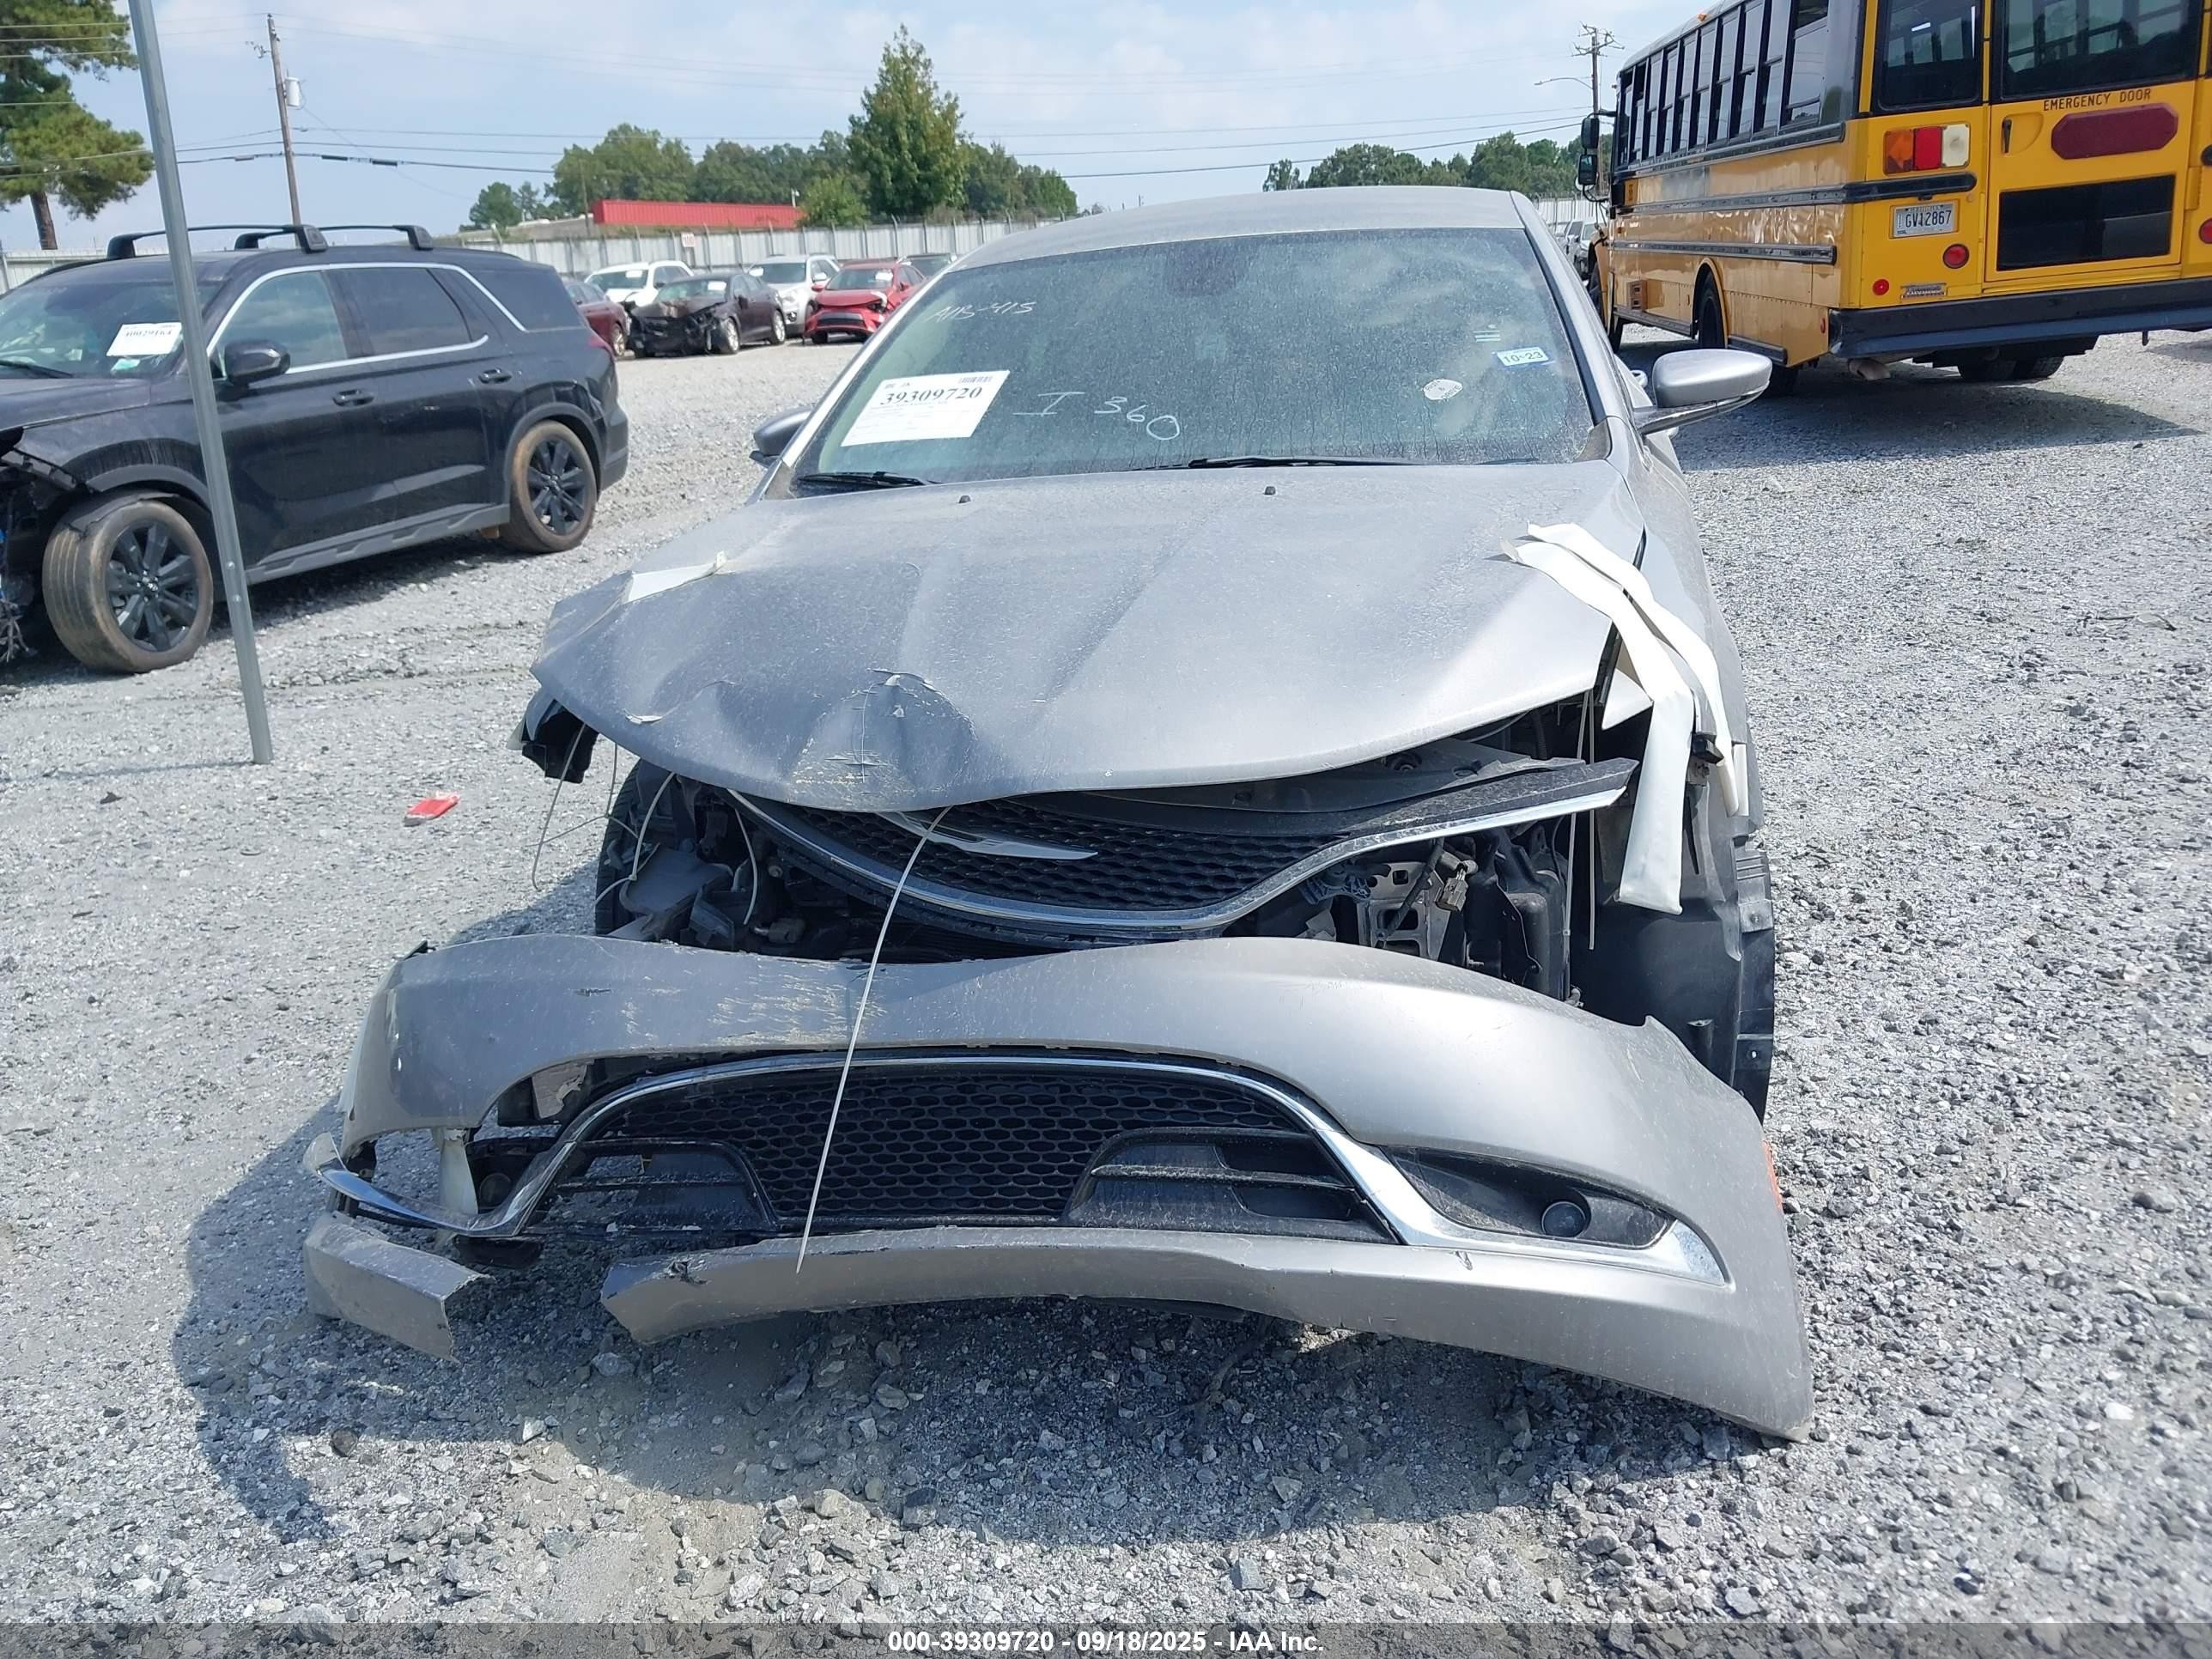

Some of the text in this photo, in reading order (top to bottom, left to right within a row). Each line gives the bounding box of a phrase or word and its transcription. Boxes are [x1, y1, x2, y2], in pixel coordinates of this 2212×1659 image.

[2043, 88, 2151, 112] EMERGENCY DOOR
[879, 386, 983, 405] 39309720
[1094, 396, 1180, 441] 360
